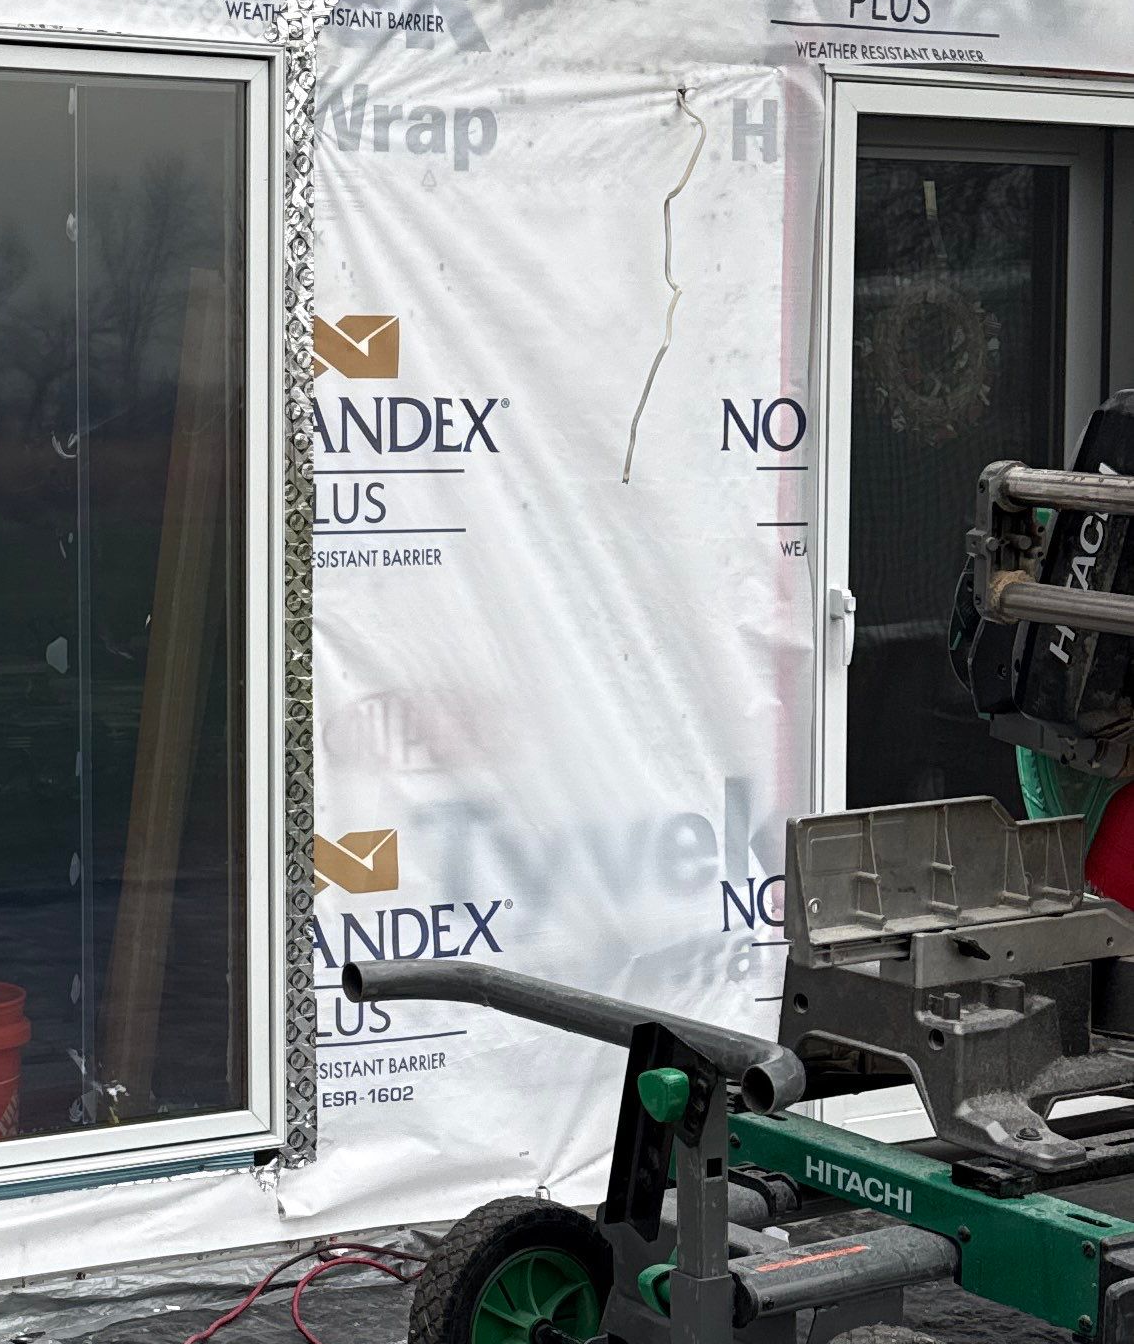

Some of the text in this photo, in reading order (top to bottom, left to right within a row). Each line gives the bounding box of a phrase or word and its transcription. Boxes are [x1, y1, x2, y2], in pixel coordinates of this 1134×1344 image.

[387, 11, 444, 34] BARRIER
[794, 40, 987, 64] WEATHER RESISTANT BARRIER
[721, 397, 807, 454] NO
[383, 546, 442, 568] BARRIER
[388, 1052, 447, 1074] BARRIER
[322, 1086, 414, 1108] ESR-1602
[805, 1154, 913, 1214] HITACHI
